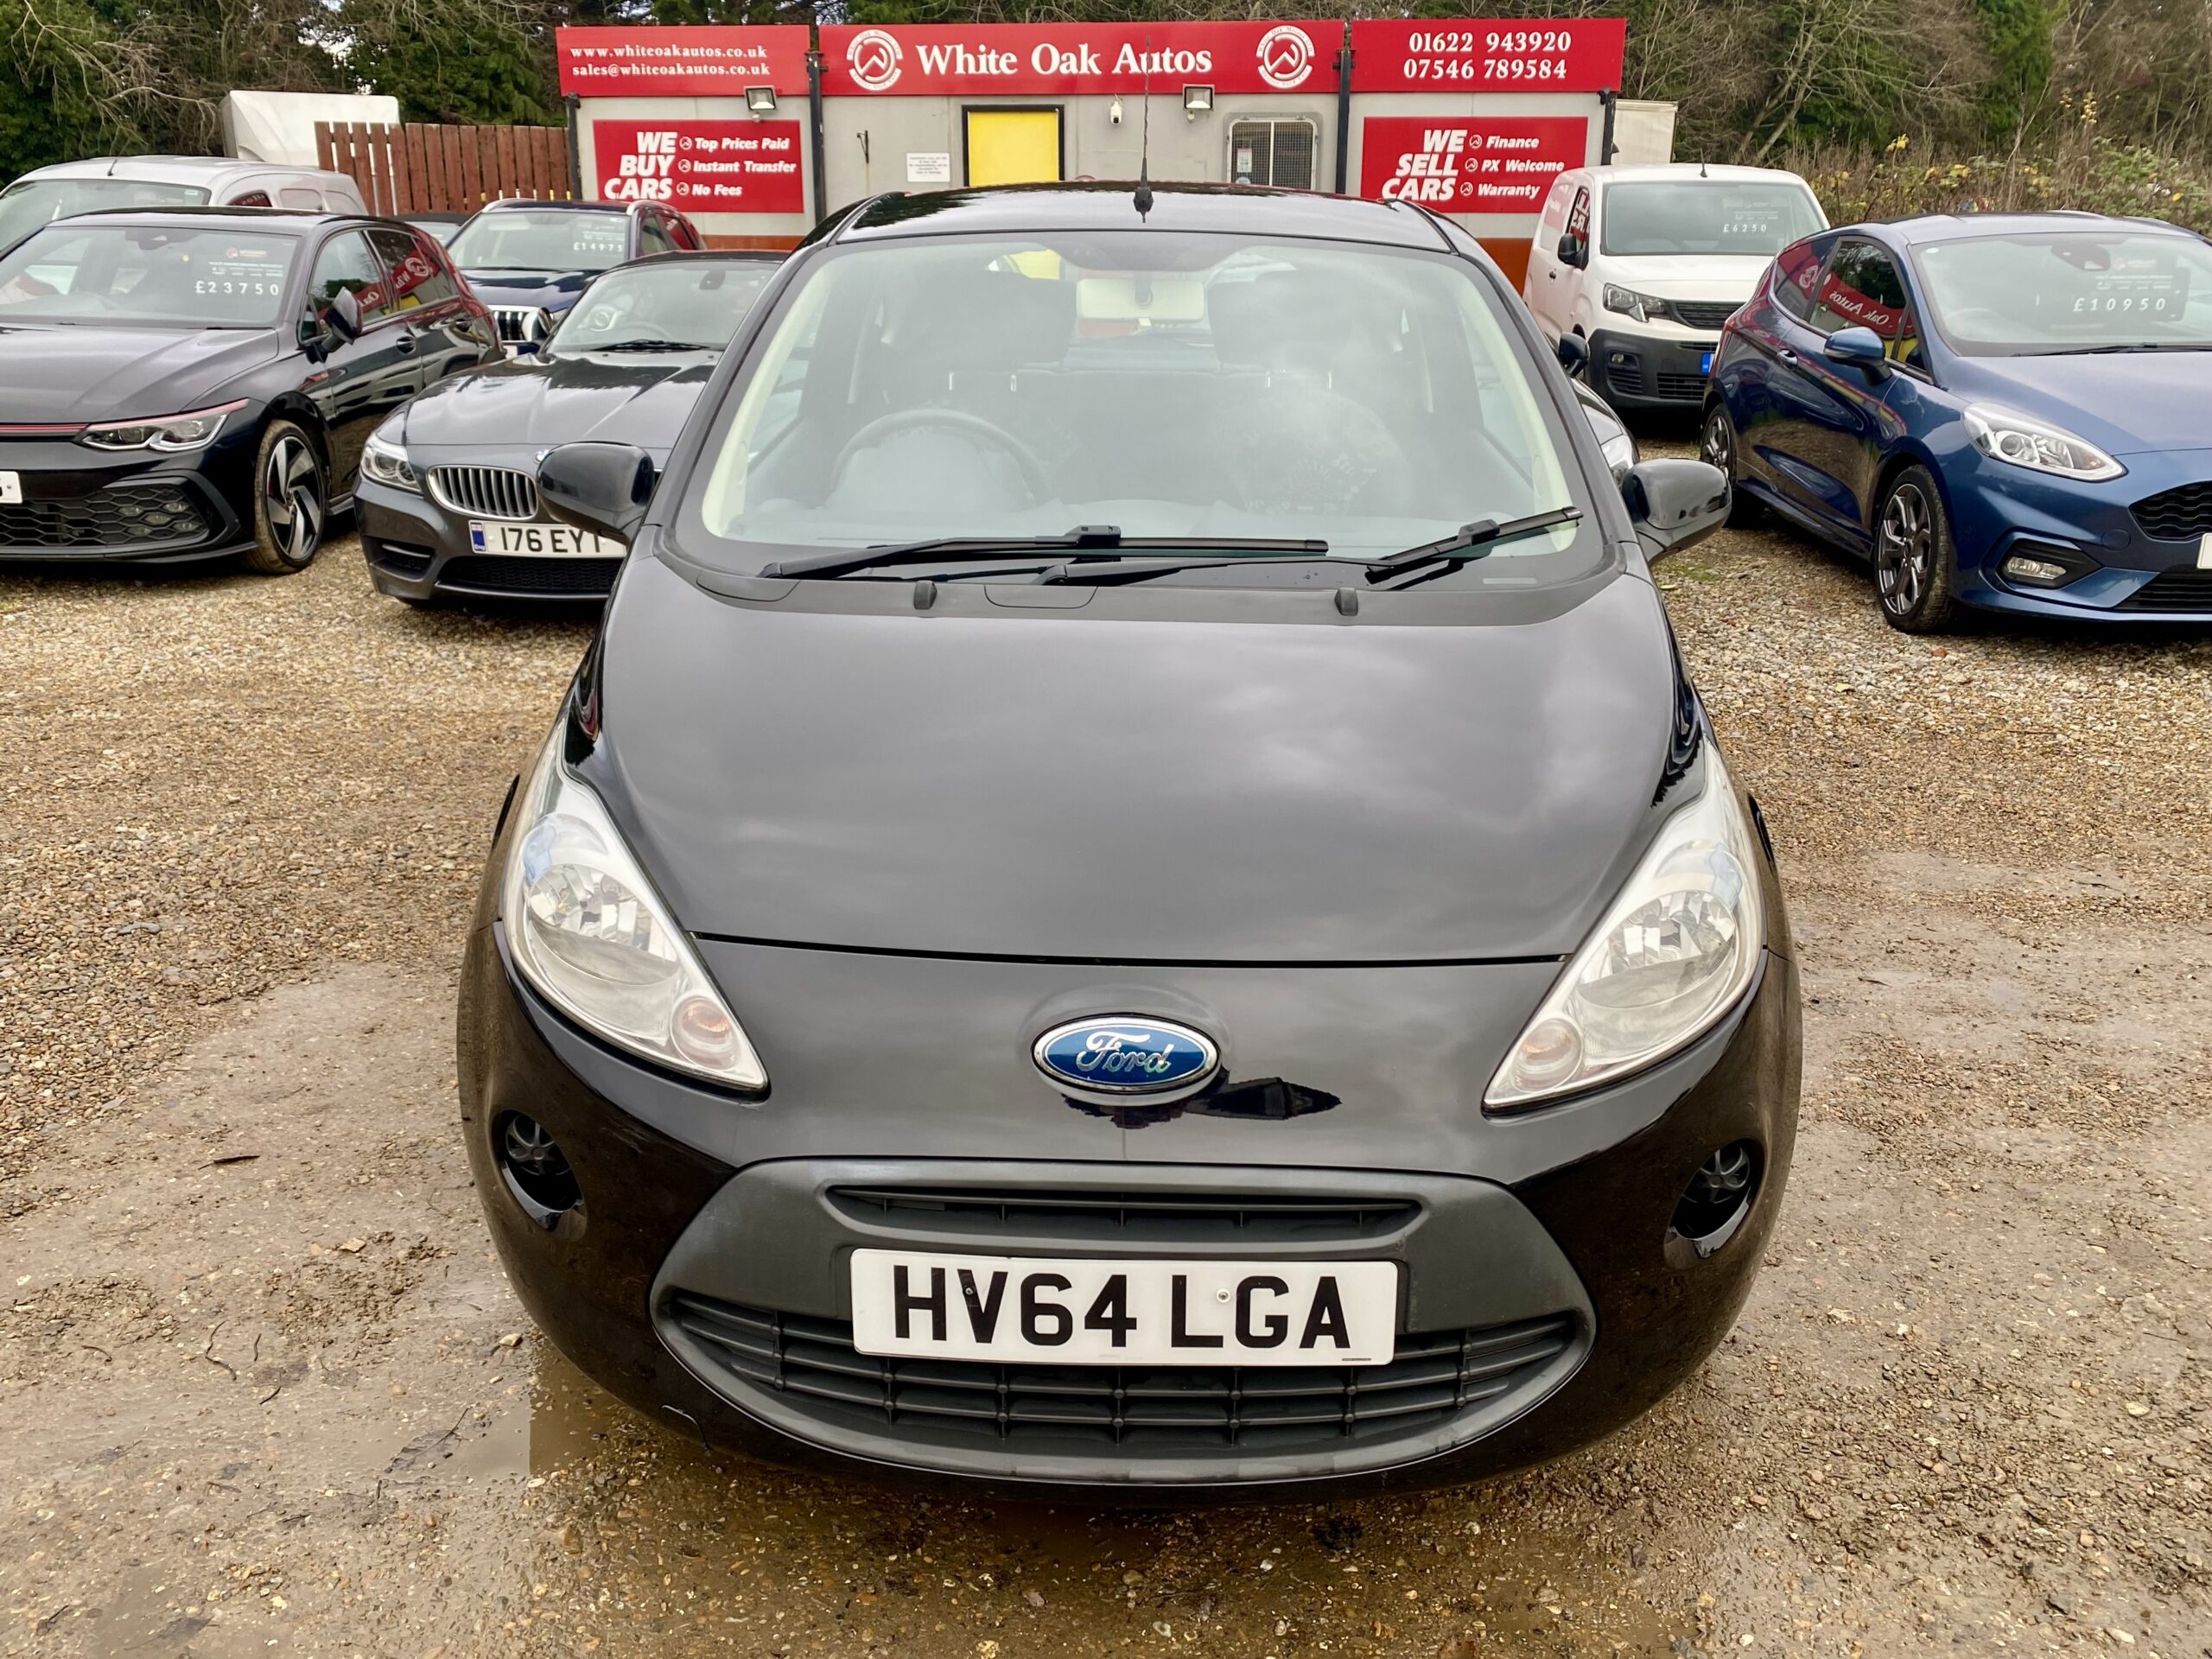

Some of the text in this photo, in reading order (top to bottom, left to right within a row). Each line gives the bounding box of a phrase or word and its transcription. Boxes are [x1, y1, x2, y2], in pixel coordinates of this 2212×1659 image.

[1409, 31, 1572, 52] 01622 943920
[570, 44, 767, 58] www.whiteoakautos.co.uk
[915, 42, 1212, 75] White Oak Autos
[572, 63, 771, 77] sales@whiteoakautos.co.uk
[1403, 58, 1567, 79] 07546 789584
[636, 131, 677, 154] WE
[695, 137, 790, 152] Top Prices Paid
[1423, 129, 1468, 152] WE
[1486, 135, 1540, 149] Finance
[619, 155, 676, 176] BUY
[693, 161, 797, 173] Instant Transfer
[1395, 153, 1459, 176] SELL
[1481, 159, 1565, 172] PX Welcome
[604, 178, 673, 200] CARS
[692, 184, 743, 196] No Fees
[1382, 178, 1457, 200] CARS
[1478, 183, 1541, 198] Warranty
[1723, 224, 1767, 232] £6250
[194, 280, 279, 296] £23750
[2072, 297, 2165, 312] £10950
[1076, 1031, 1174, 1073] Ford
[893, 1264, 1352, 1350] HV64 LGA
